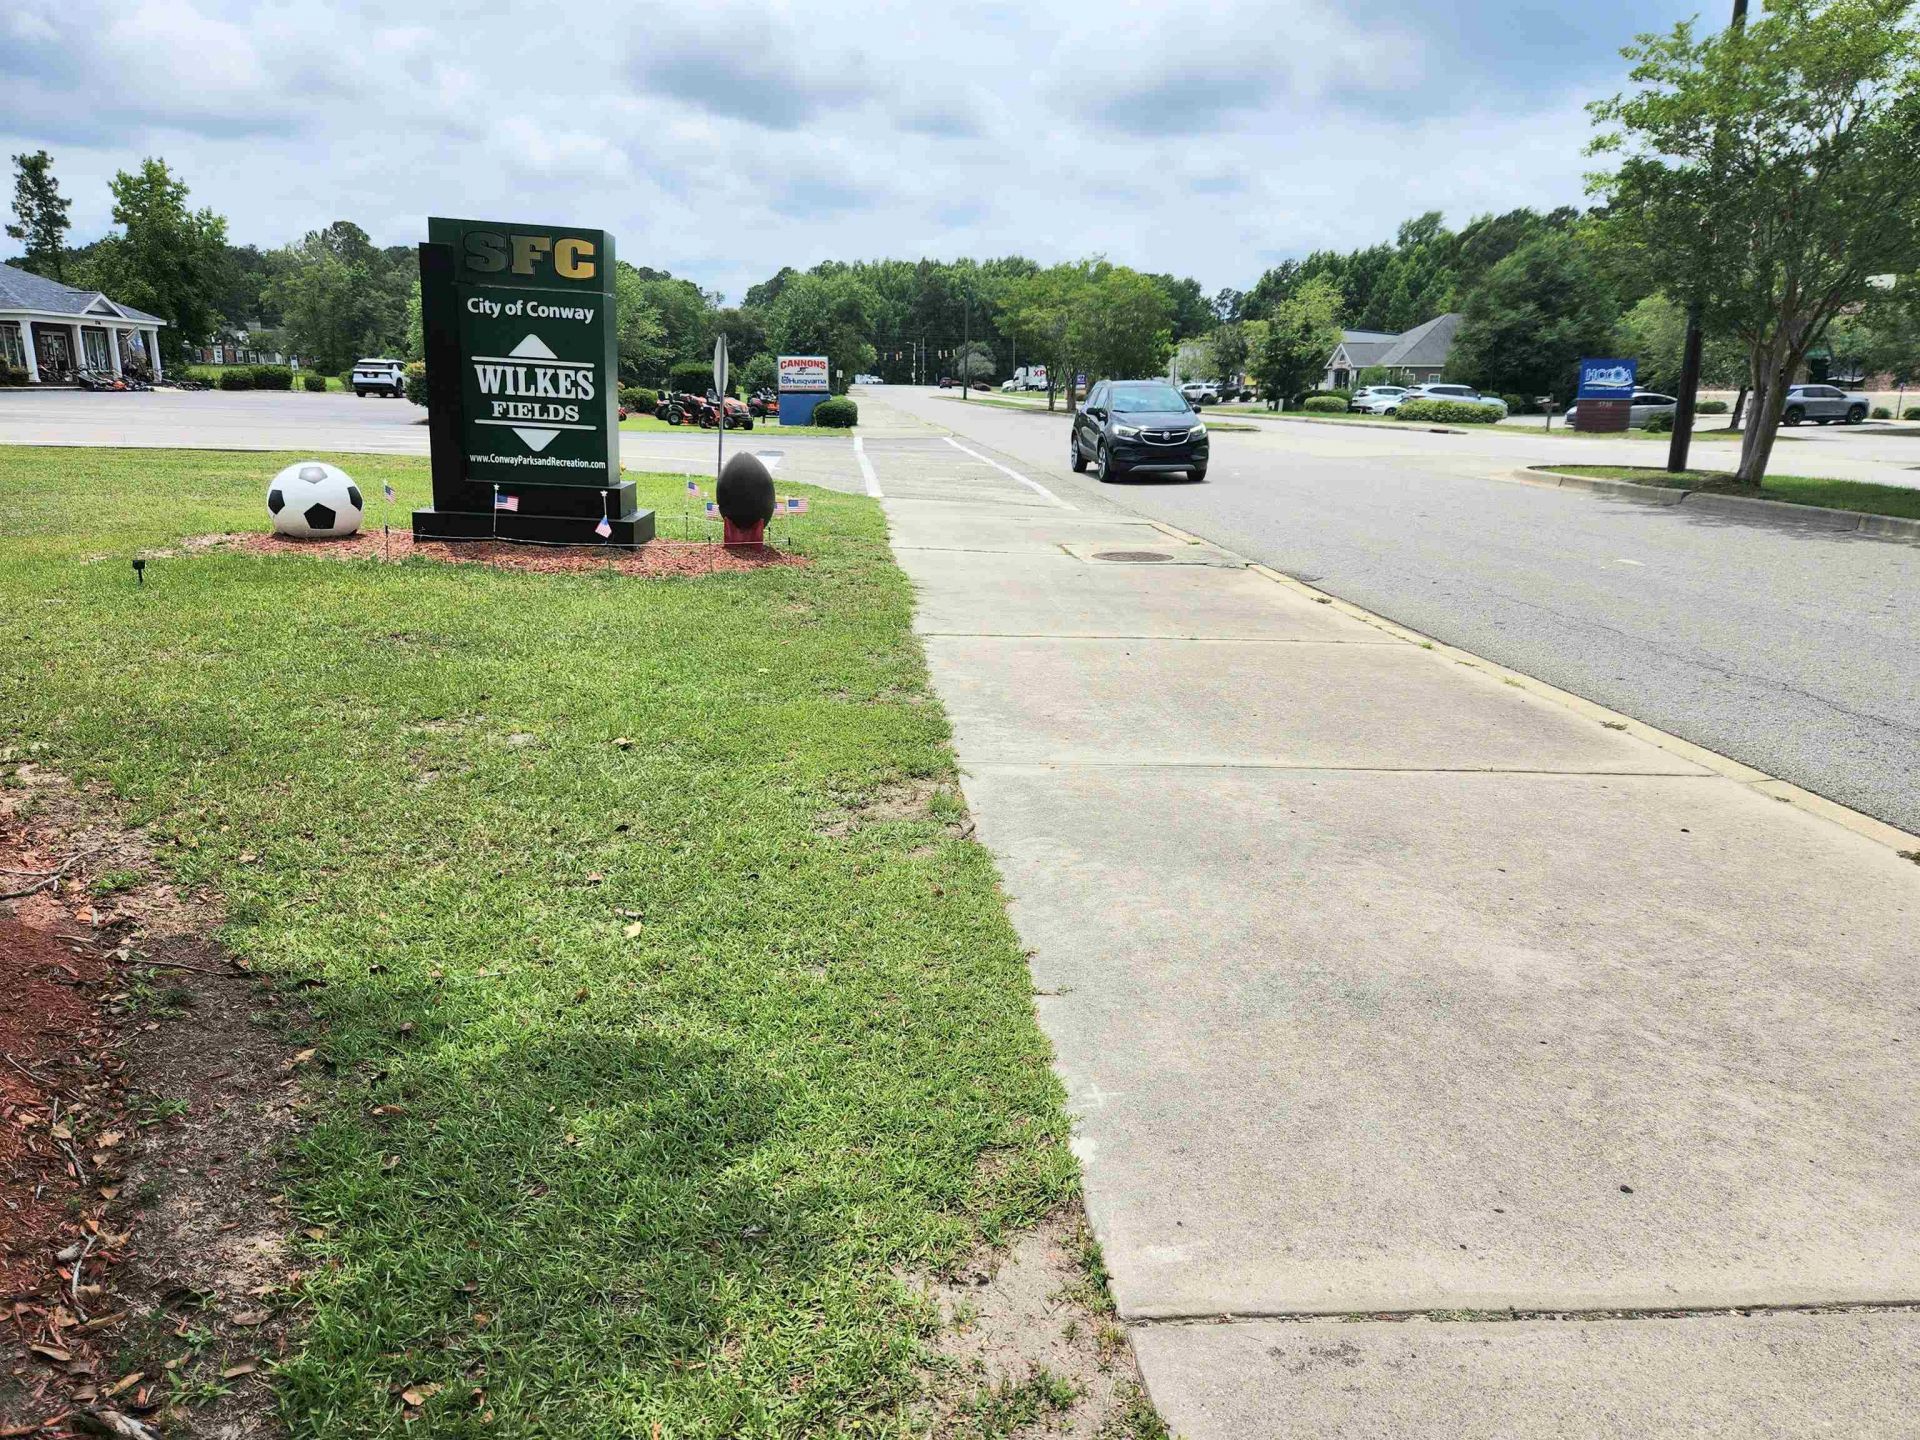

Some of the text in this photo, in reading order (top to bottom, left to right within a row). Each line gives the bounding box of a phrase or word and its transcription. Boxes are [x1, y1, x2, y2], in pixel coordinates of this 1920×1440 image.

[463, 231, 597, 279] SFC
[467, 297, 595, 324] City of Conway
[780, 359, 826, 370] CANNONS
[474, 364, 595, 400] WILKES
[491, 401, 579, 421] FIELDS
[469, 453, 606, 469] www.ConwayParksandRecreation.com
